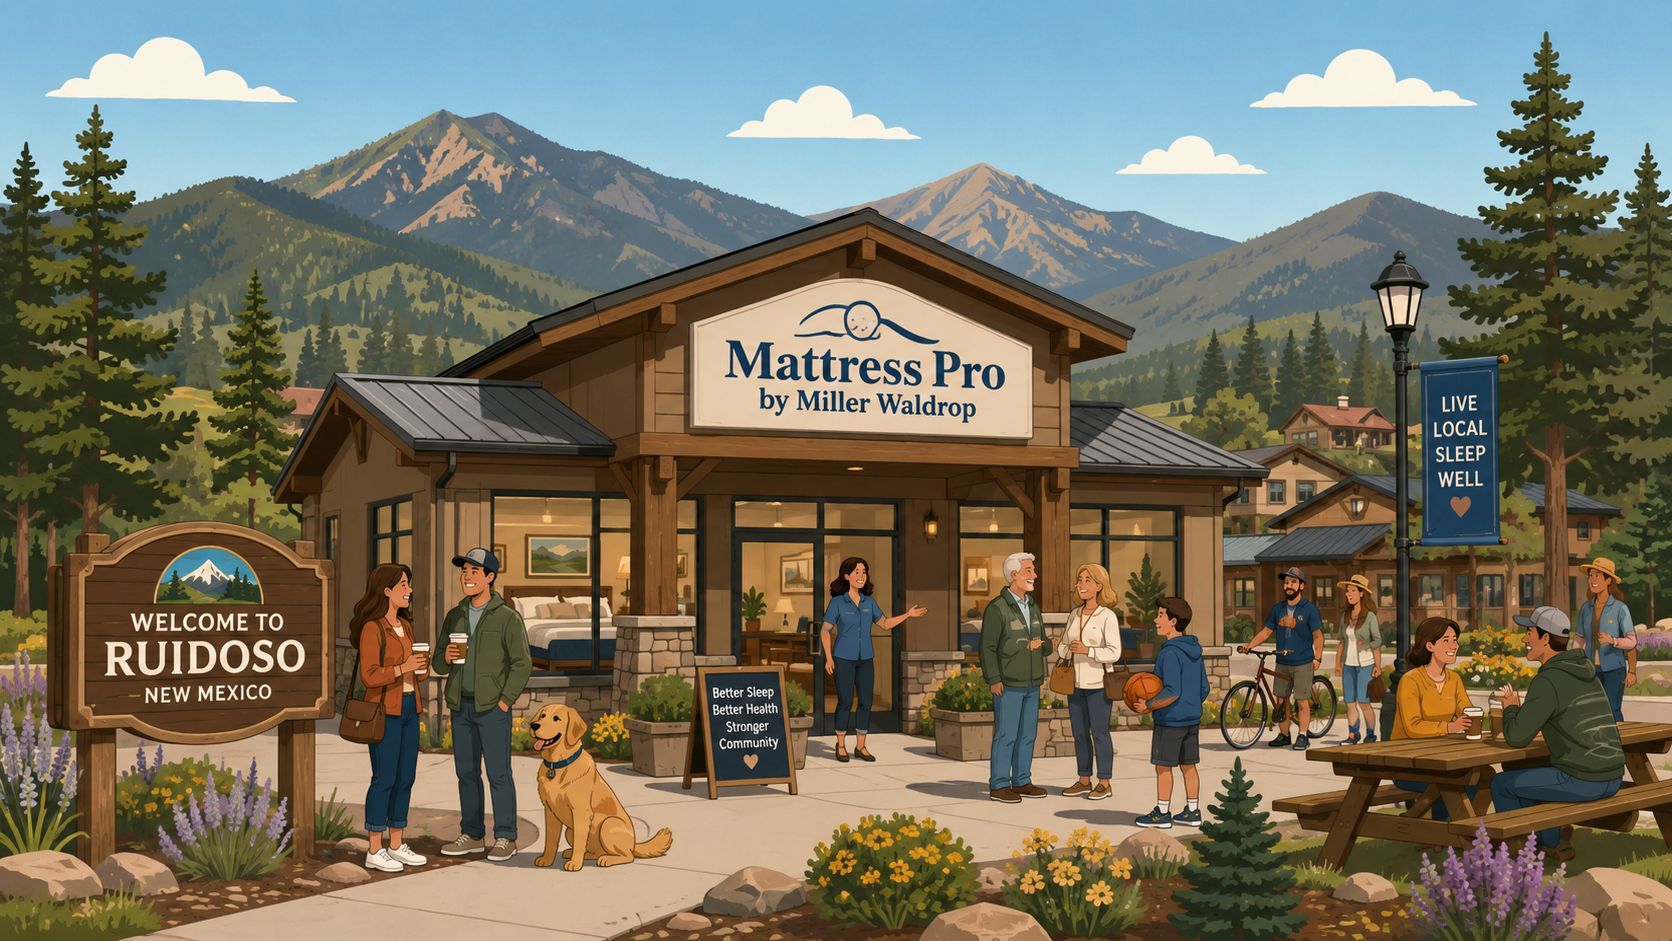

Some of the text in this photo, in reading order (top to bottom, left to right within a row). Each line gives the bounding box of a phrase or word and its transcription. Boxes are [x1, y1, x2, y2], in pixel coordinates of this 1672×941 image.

[725, 339, 1006, 390] Mattress Pro
[759, 387, 977, 423] by Miller Waldrop
[1442, 394, 1477, 413] LIVE
[1433, 419, 1488, 438] LOCAL
[1435, 445, 1486, 463] SLEEP
[1437, 470, 1484, 488] WELL
[130, 612, 284, 632] WELCOME TO
[104, 639, 306, 676] RUIDOSO
[145, 683, 272, 704] NEW MEXICO
[712, 686, 774, 700] Better Sleep
[712, 702, 778, 716] Better Health
[725, 721, 769, 735] Stronger
[719, 736, 779, 750] Community
